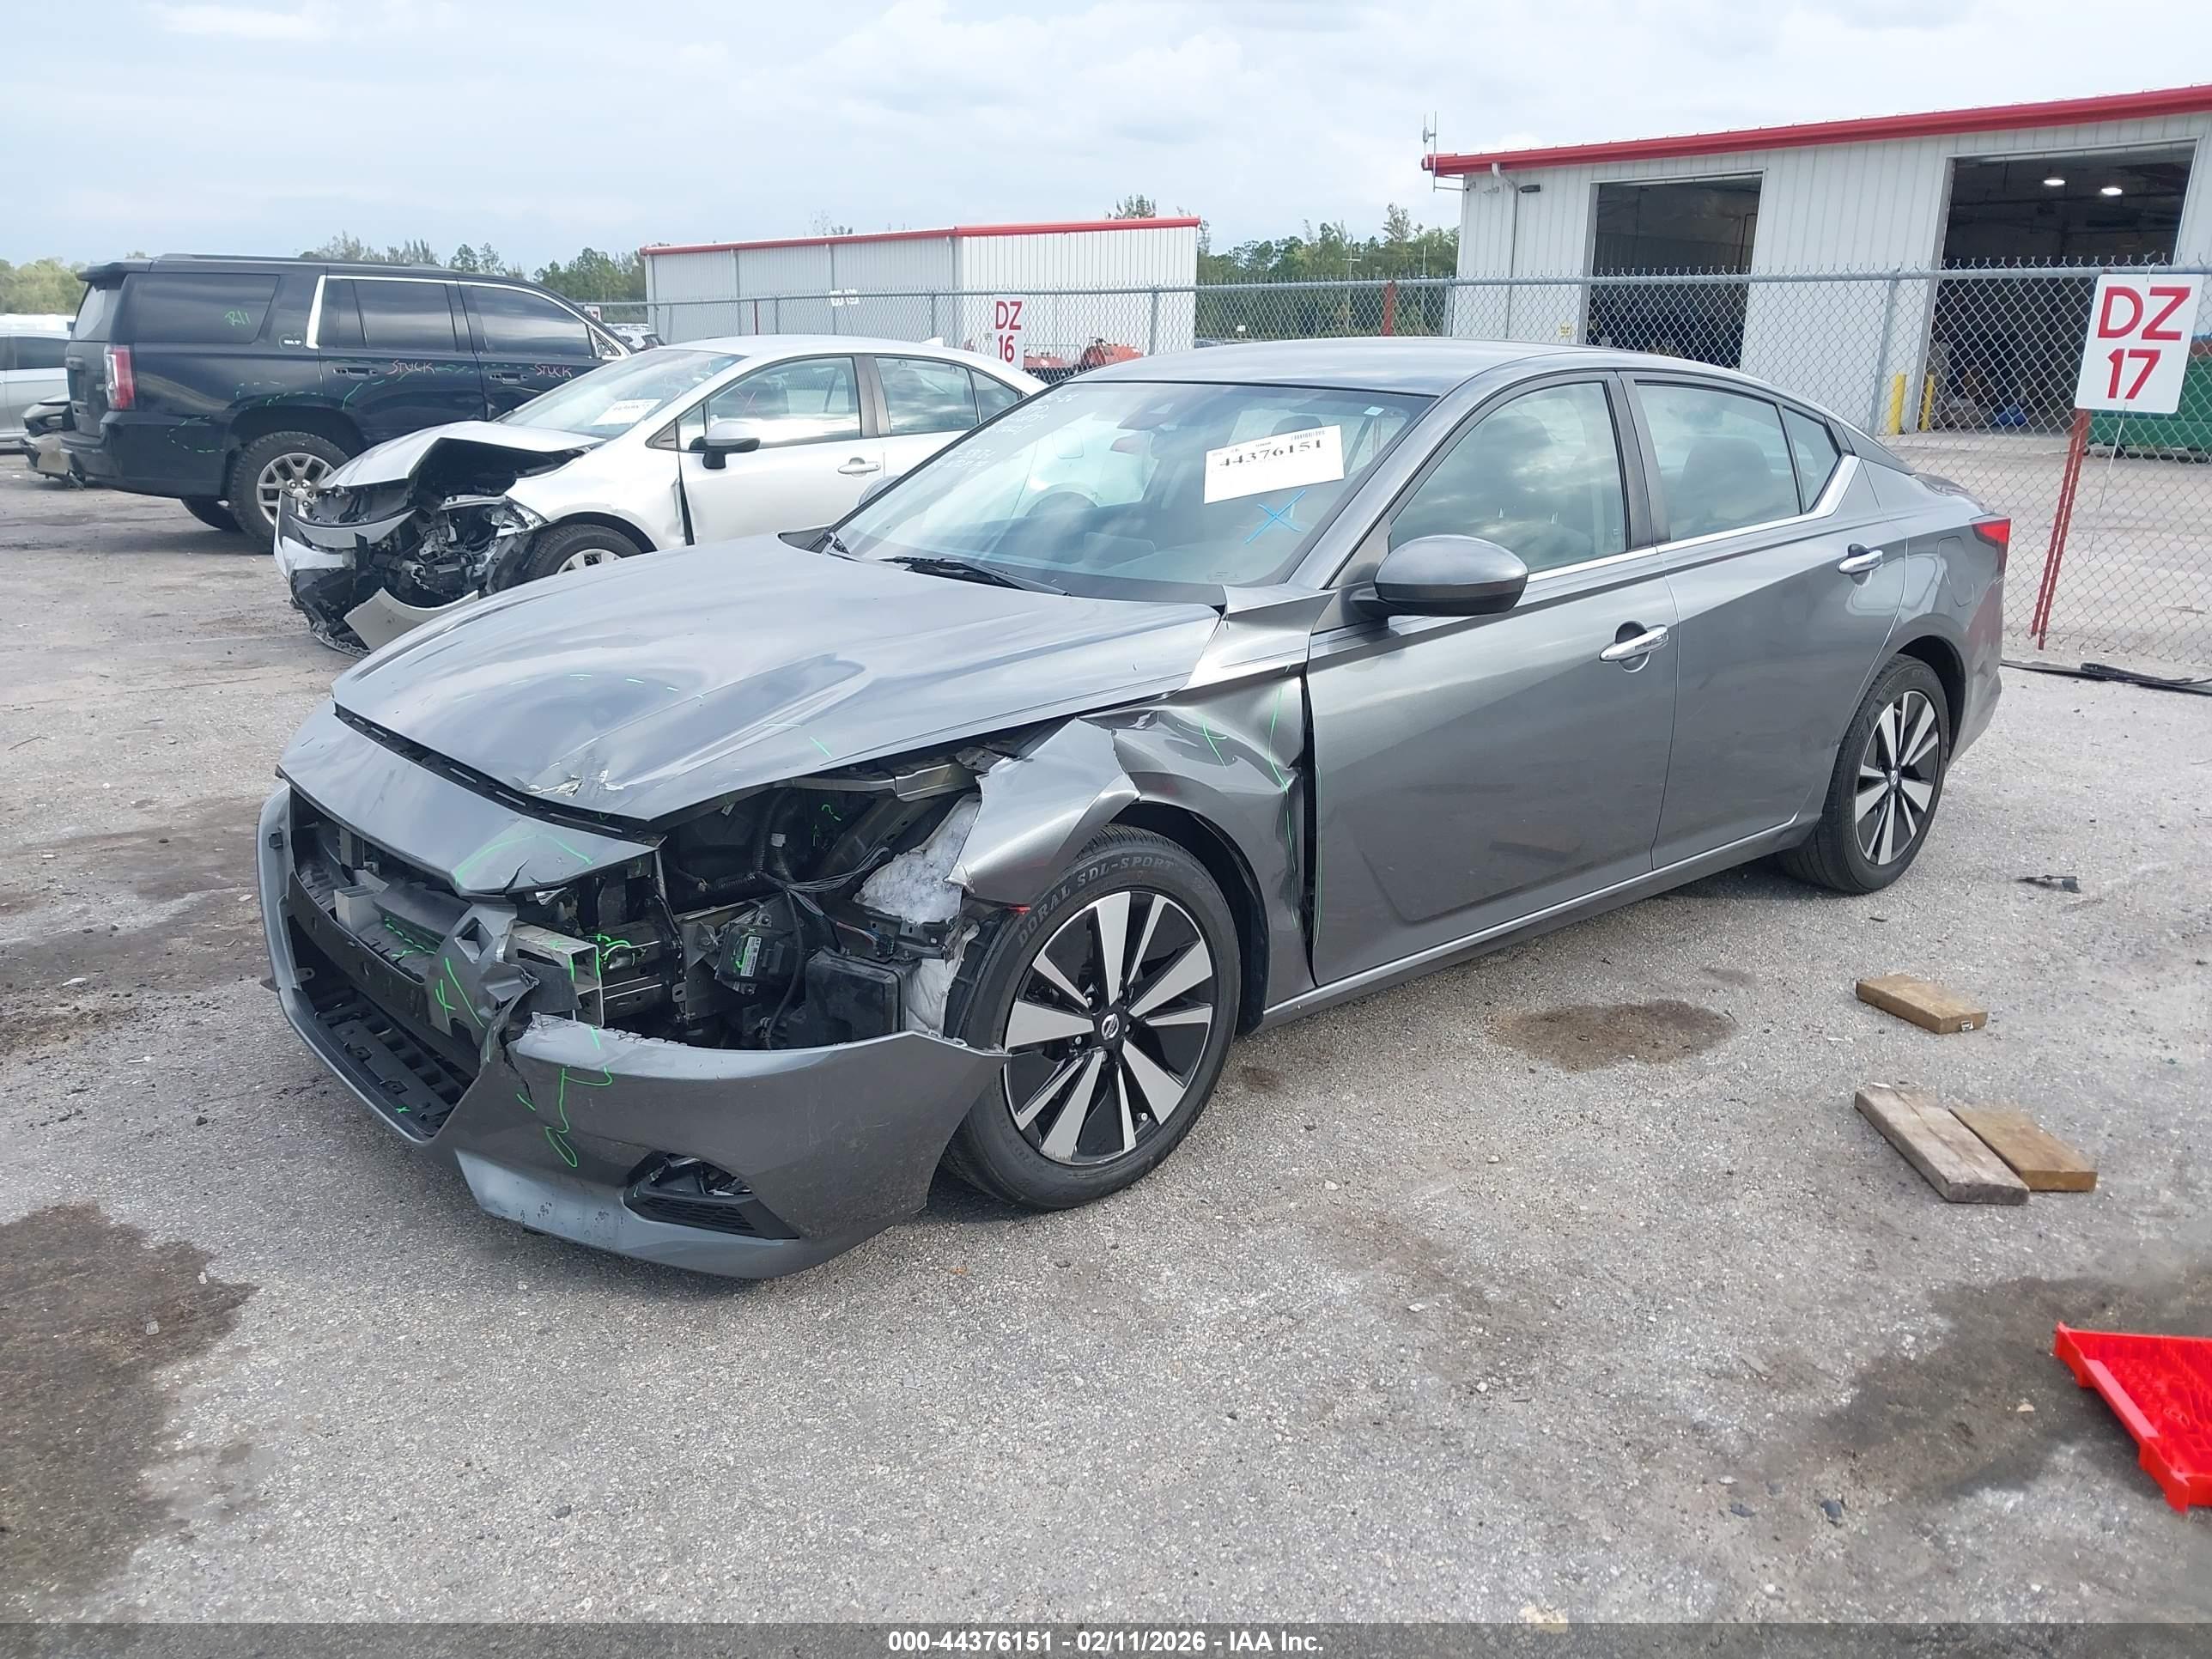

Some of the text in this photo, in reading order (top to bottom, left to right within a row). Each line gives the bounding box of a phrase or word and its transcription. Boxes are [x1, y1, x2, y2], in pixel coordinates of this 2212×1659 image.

[995, 301, 1023, 331] DZ
[2097, 286, 2192, 341] DZ
[998, 334, 1015, 363] 16
[386, 359, 435, 375] STUCK
[534, 363, 573, 379] STUCK
[2107, 348, 2162, 400] 17
[1219, 439, 1322, 466] 44376151
[1017, 885, 1071, 948] DORAL
